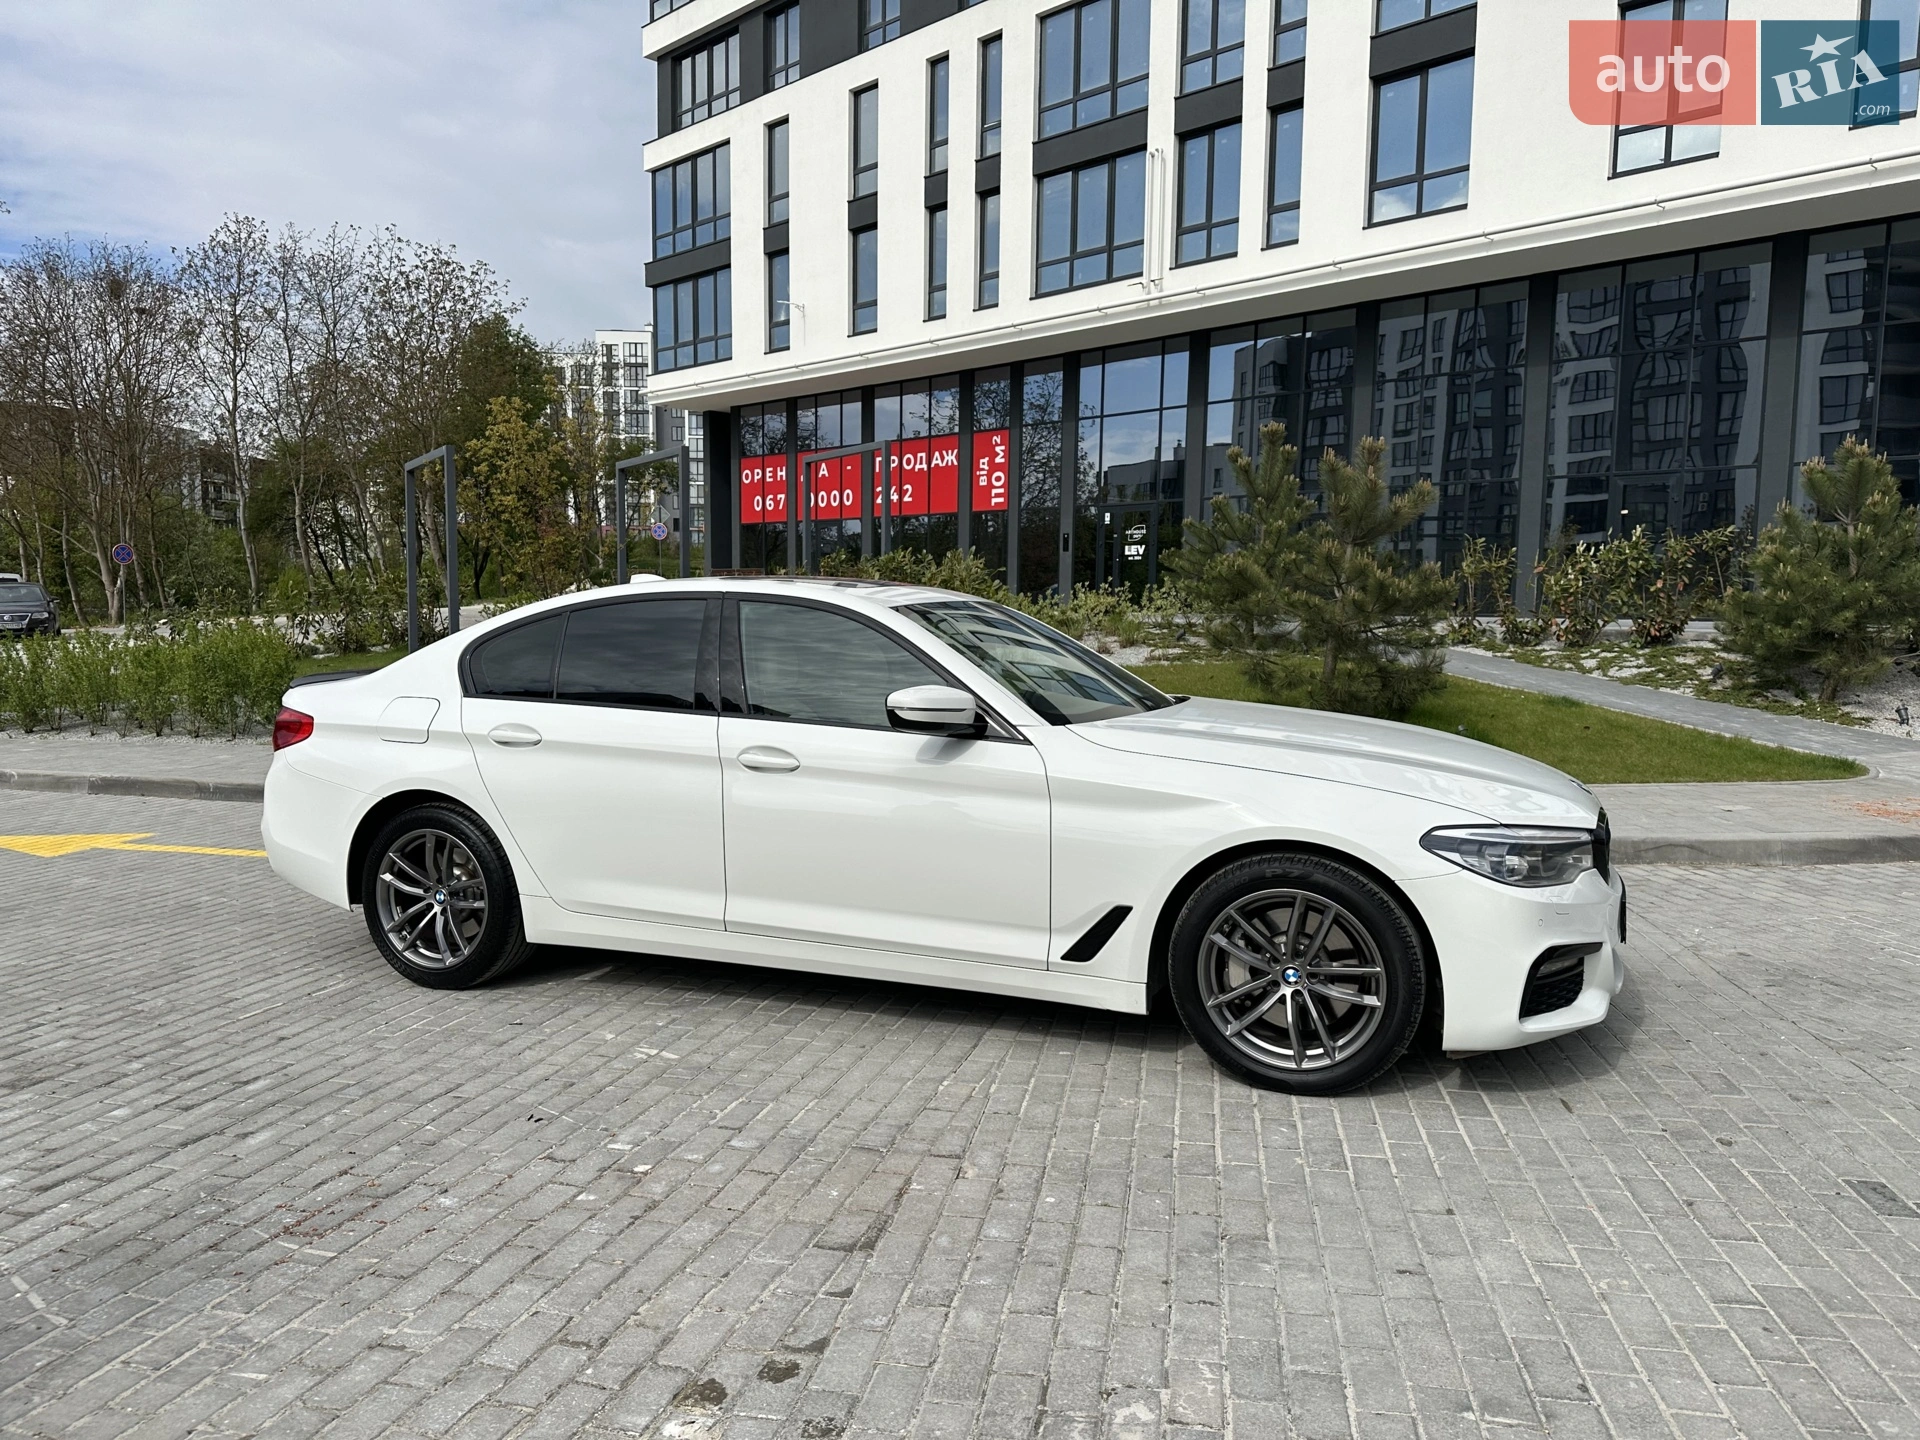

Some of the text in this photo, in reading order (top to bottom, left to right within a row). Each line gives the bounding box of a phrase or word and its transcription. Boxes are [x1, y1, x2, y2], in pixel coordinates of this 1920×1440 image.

[742, 462, 829, 484] ОРЕНА
[976, 456, 990, 486] від
[753, 493, 786, 511] 067
[875, 484, 913, 504] 242
[991, 470, 1005, 507] 110
[1124, 544, 1146, 555] LEV
[1265, 868, 1305, 878] P7
